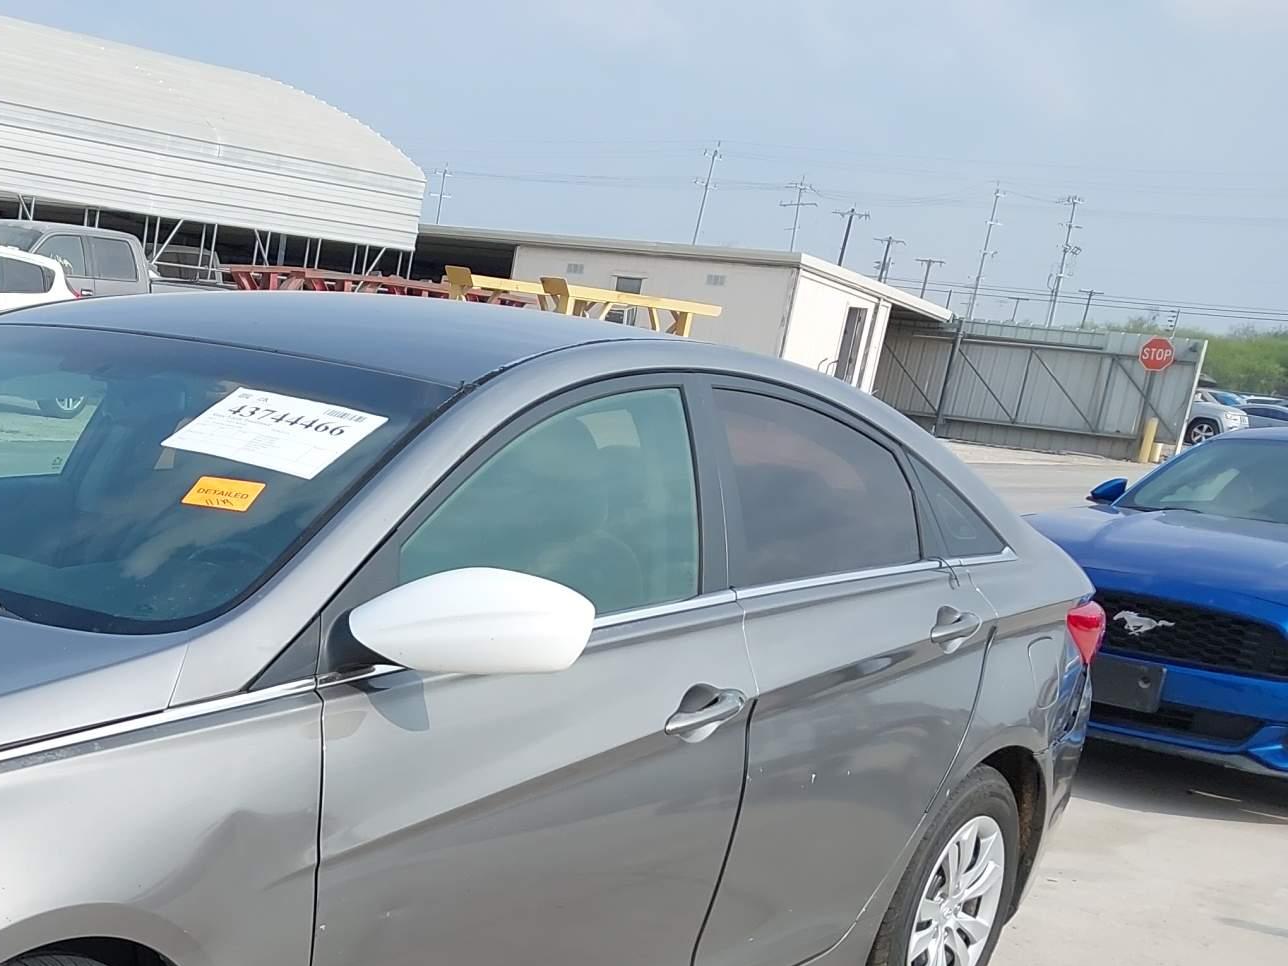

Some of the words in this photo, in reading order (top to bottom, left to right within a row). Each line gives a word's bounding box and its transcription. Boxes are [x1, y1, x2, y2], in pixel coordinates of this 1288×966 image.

[1142, 347, 1172, 361] STOP
[228, 404, 352, 436] 43744466
[196, 487, 249, 500] DETAILED
